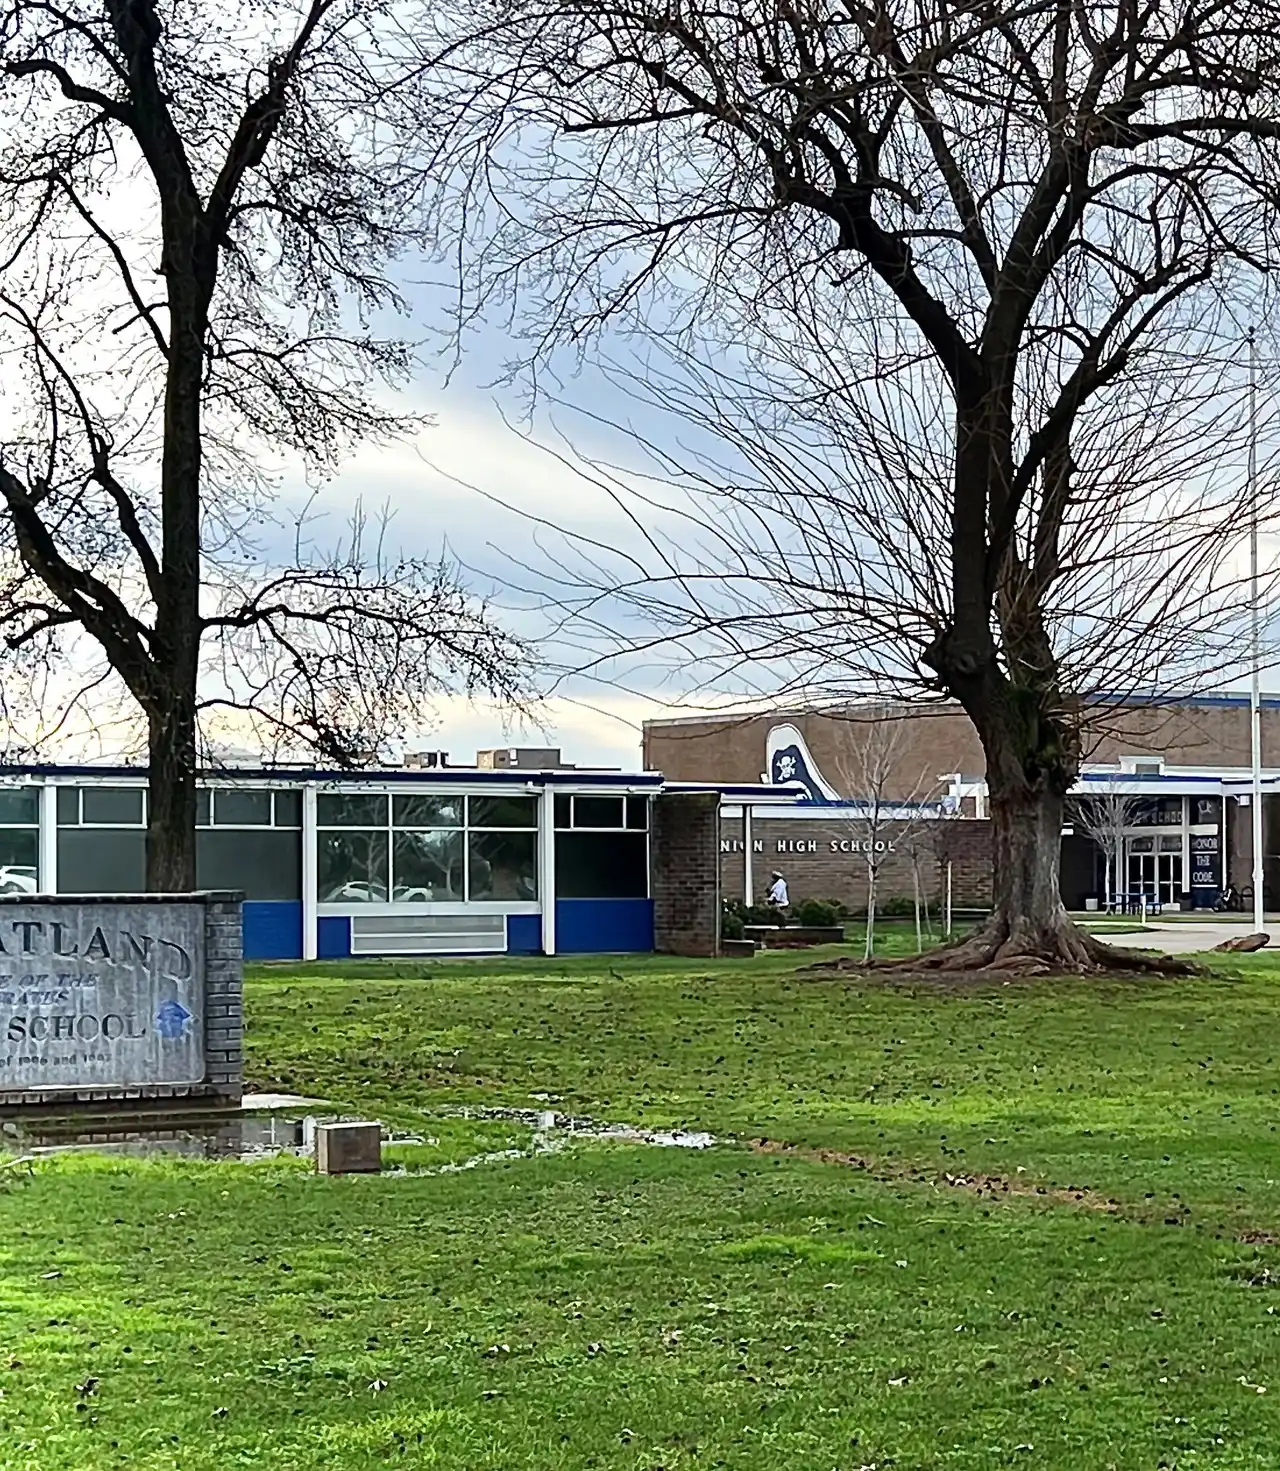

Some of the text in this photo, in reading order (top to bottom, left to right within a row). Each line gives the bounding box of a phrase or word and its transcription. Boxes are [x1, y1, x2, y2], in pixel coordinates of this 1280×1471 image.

[777, 840, 817, 852] HIGH
[830, 840, 896, 852] SCHOOL
[7, 1014, 147, 1043] SCHOOL
[53, 1054, 77, 1066] and
